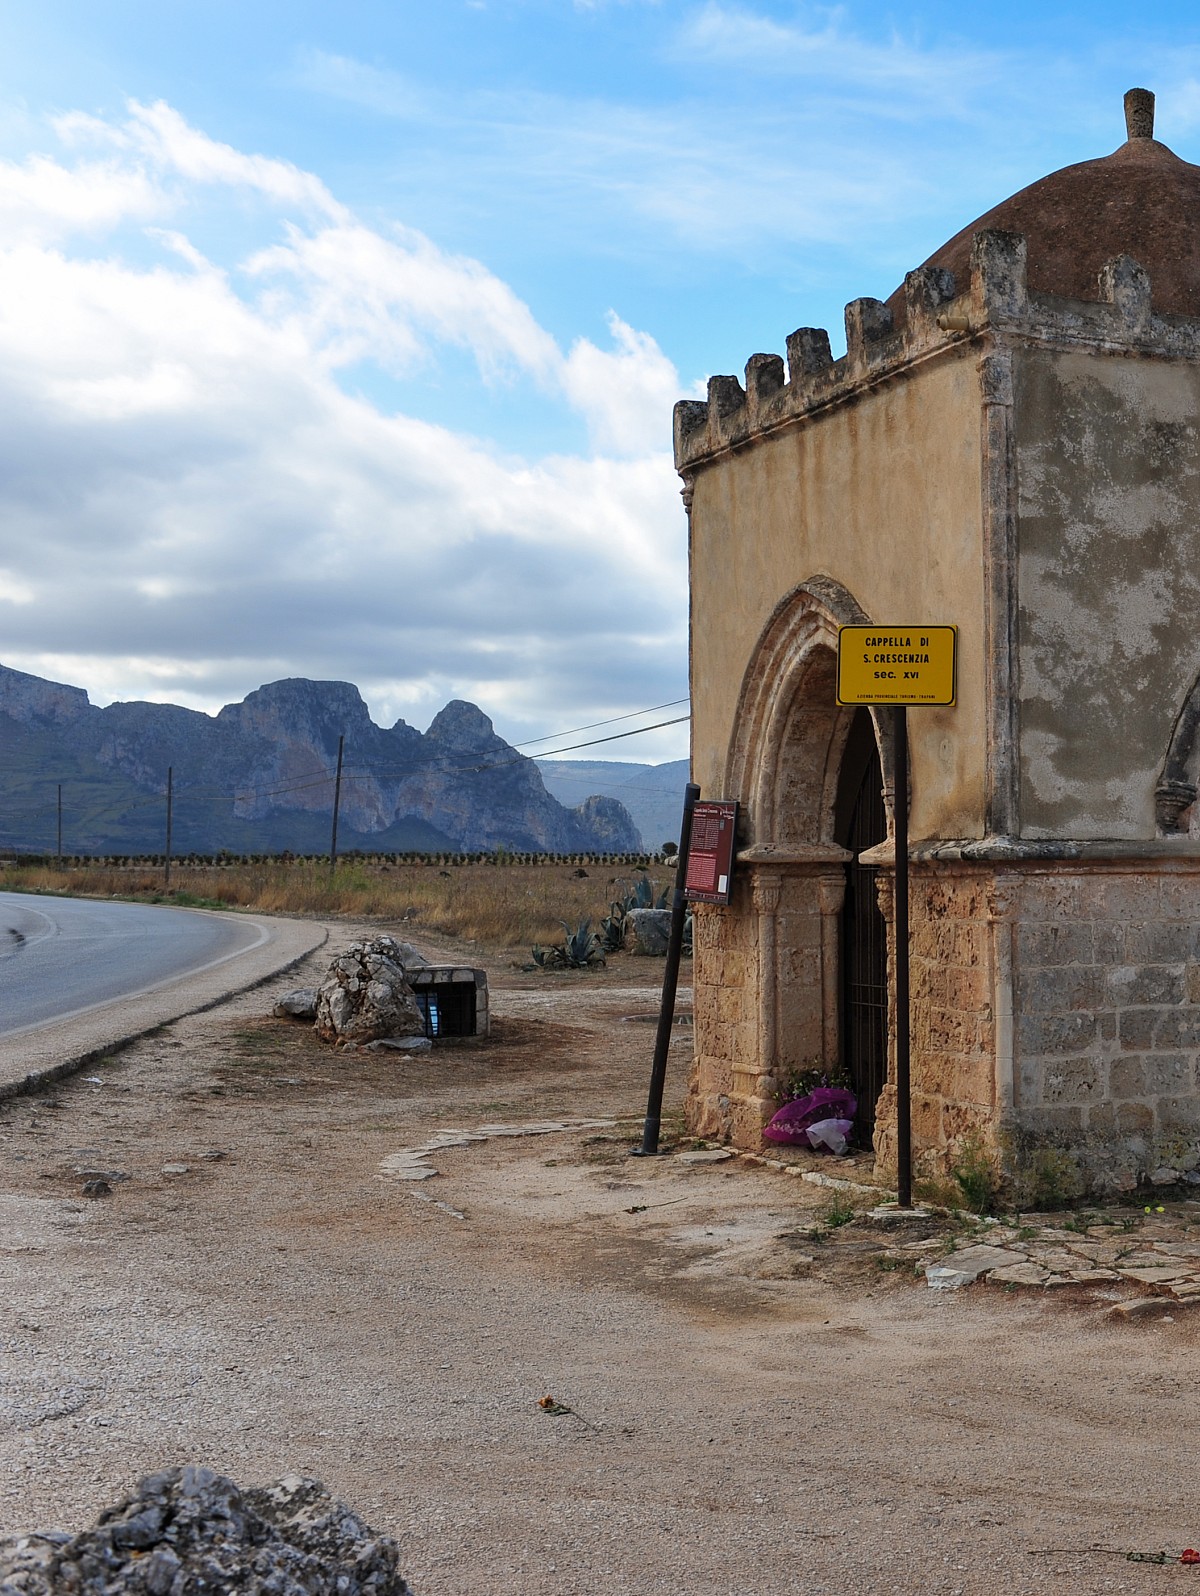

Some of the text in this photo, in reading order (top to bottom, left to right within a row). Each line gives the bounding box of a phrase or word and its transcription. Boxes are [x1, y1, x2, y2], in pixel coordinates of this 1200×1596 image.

[865, 637, 929, 647] CAPPELLA DI
[863, 653, 929, 663] S. CRESCENZIA
